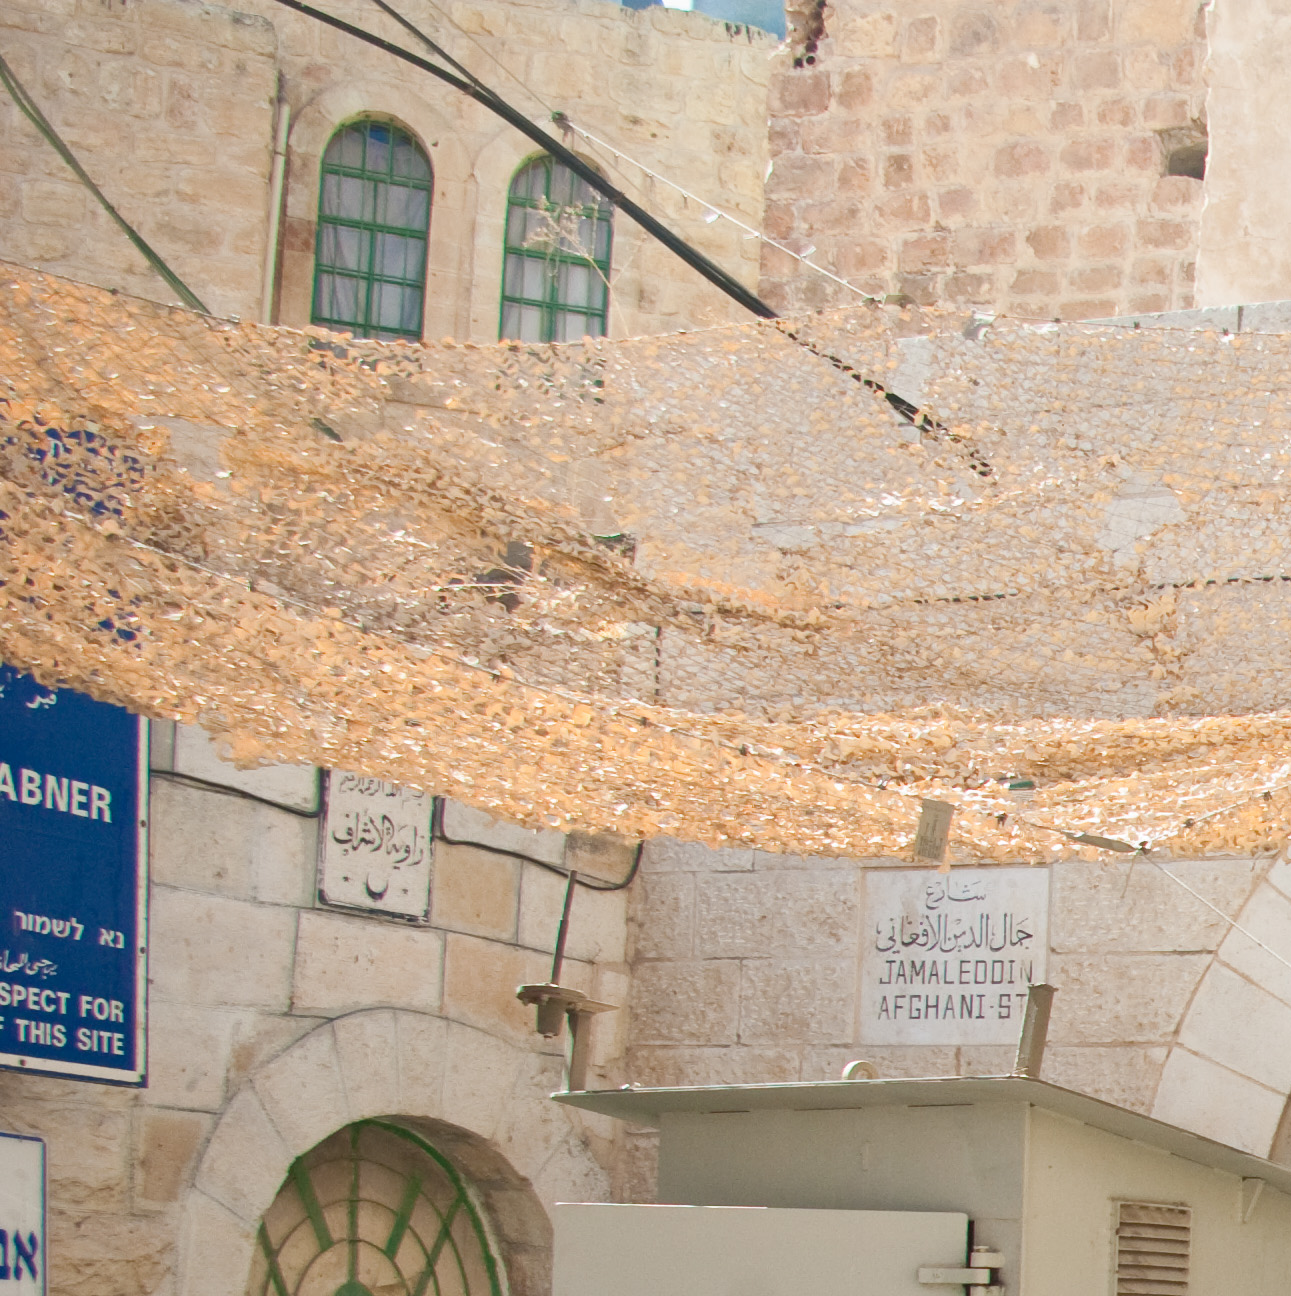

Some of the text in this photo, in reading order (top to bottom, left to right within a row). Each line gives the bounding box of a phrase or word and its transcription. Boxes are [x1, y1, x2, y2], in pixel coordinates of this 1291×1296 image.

[0, 762, 112, 823] ABNER
[925, 875, 987, 911] شارع
[13, 911, 125, 949] נא לשמור
[879, 959, 1033, 985] JAMALEDDIN
[79, 995, 125, 1023] FOR
[15, 1018, 67, 1048] THIS
[76, 1027, 125, 1056] SITE
